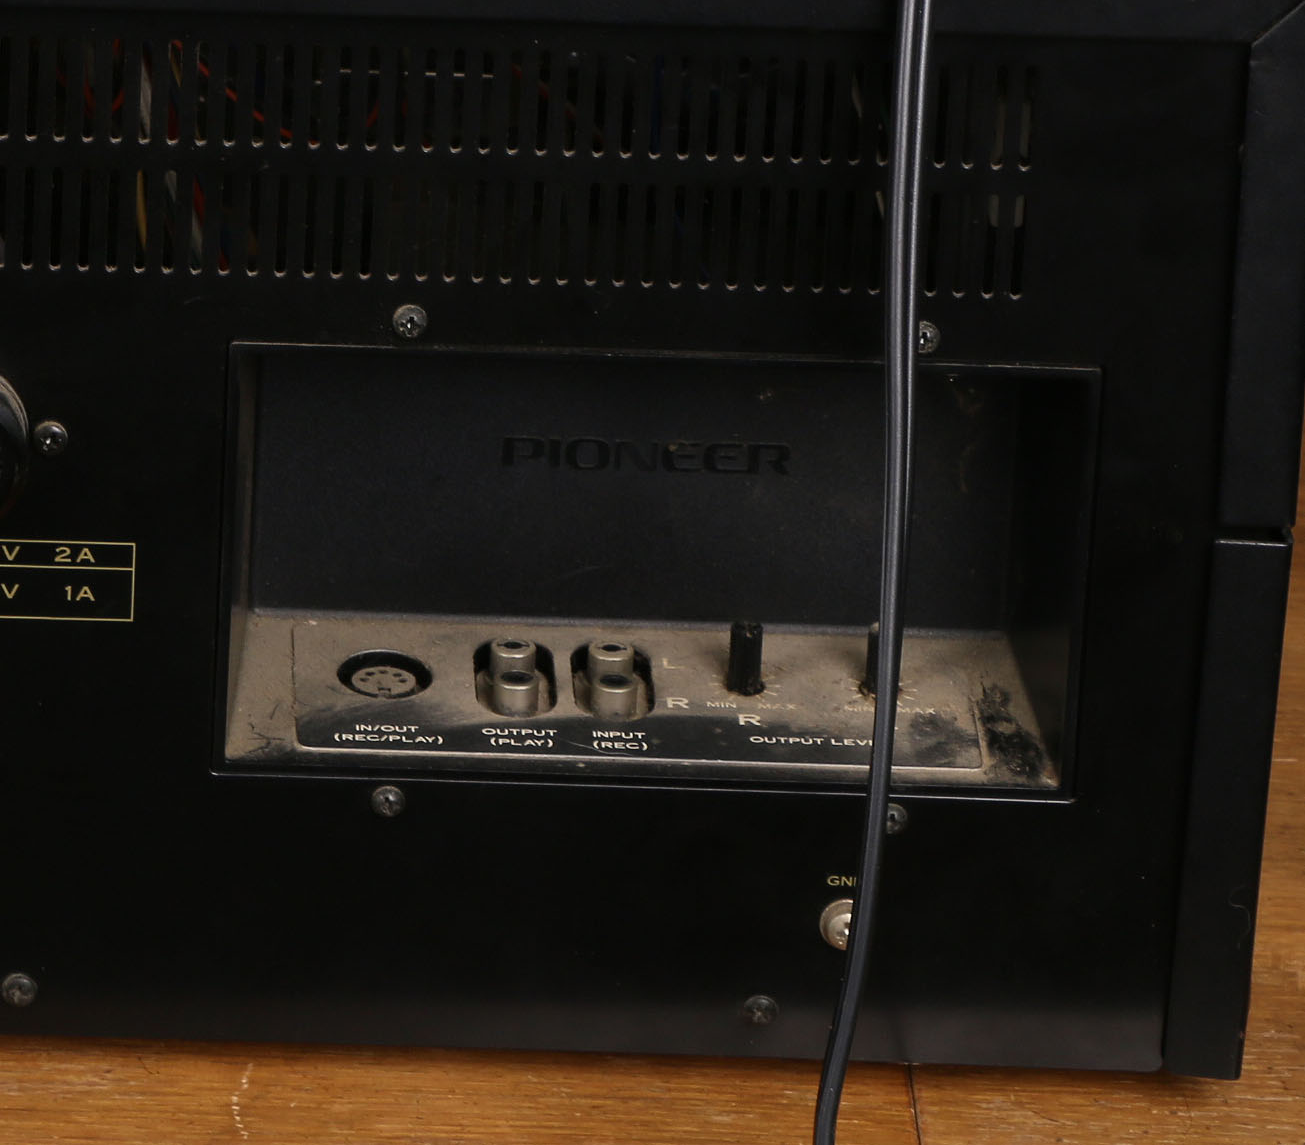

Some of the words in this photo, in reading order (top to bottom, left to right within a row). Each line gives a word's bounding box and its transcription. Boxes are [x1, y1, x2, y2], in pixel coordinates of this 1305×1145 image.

[502, 436, 791, 475] PIONEER
[666, 697, 690, 709] R
[706, 701, 737, 709] MIN
[738, 714, 761, 726] R
[355, 724, 419, 734] IN/OUT
[482, 727, 558, 737] OUTPUT
[592, 730, 647, 740] INPUT
[334, 732, 444, 745] (REC/PLAY)
[490, 737, 554, 749] (PLAY)
[749, 735, 824, 746] OUTPUT
[831, 737, 874, 747] LEV
[592, 740, 648, 752] (REC)
[827, 874, 857, 887] GN
